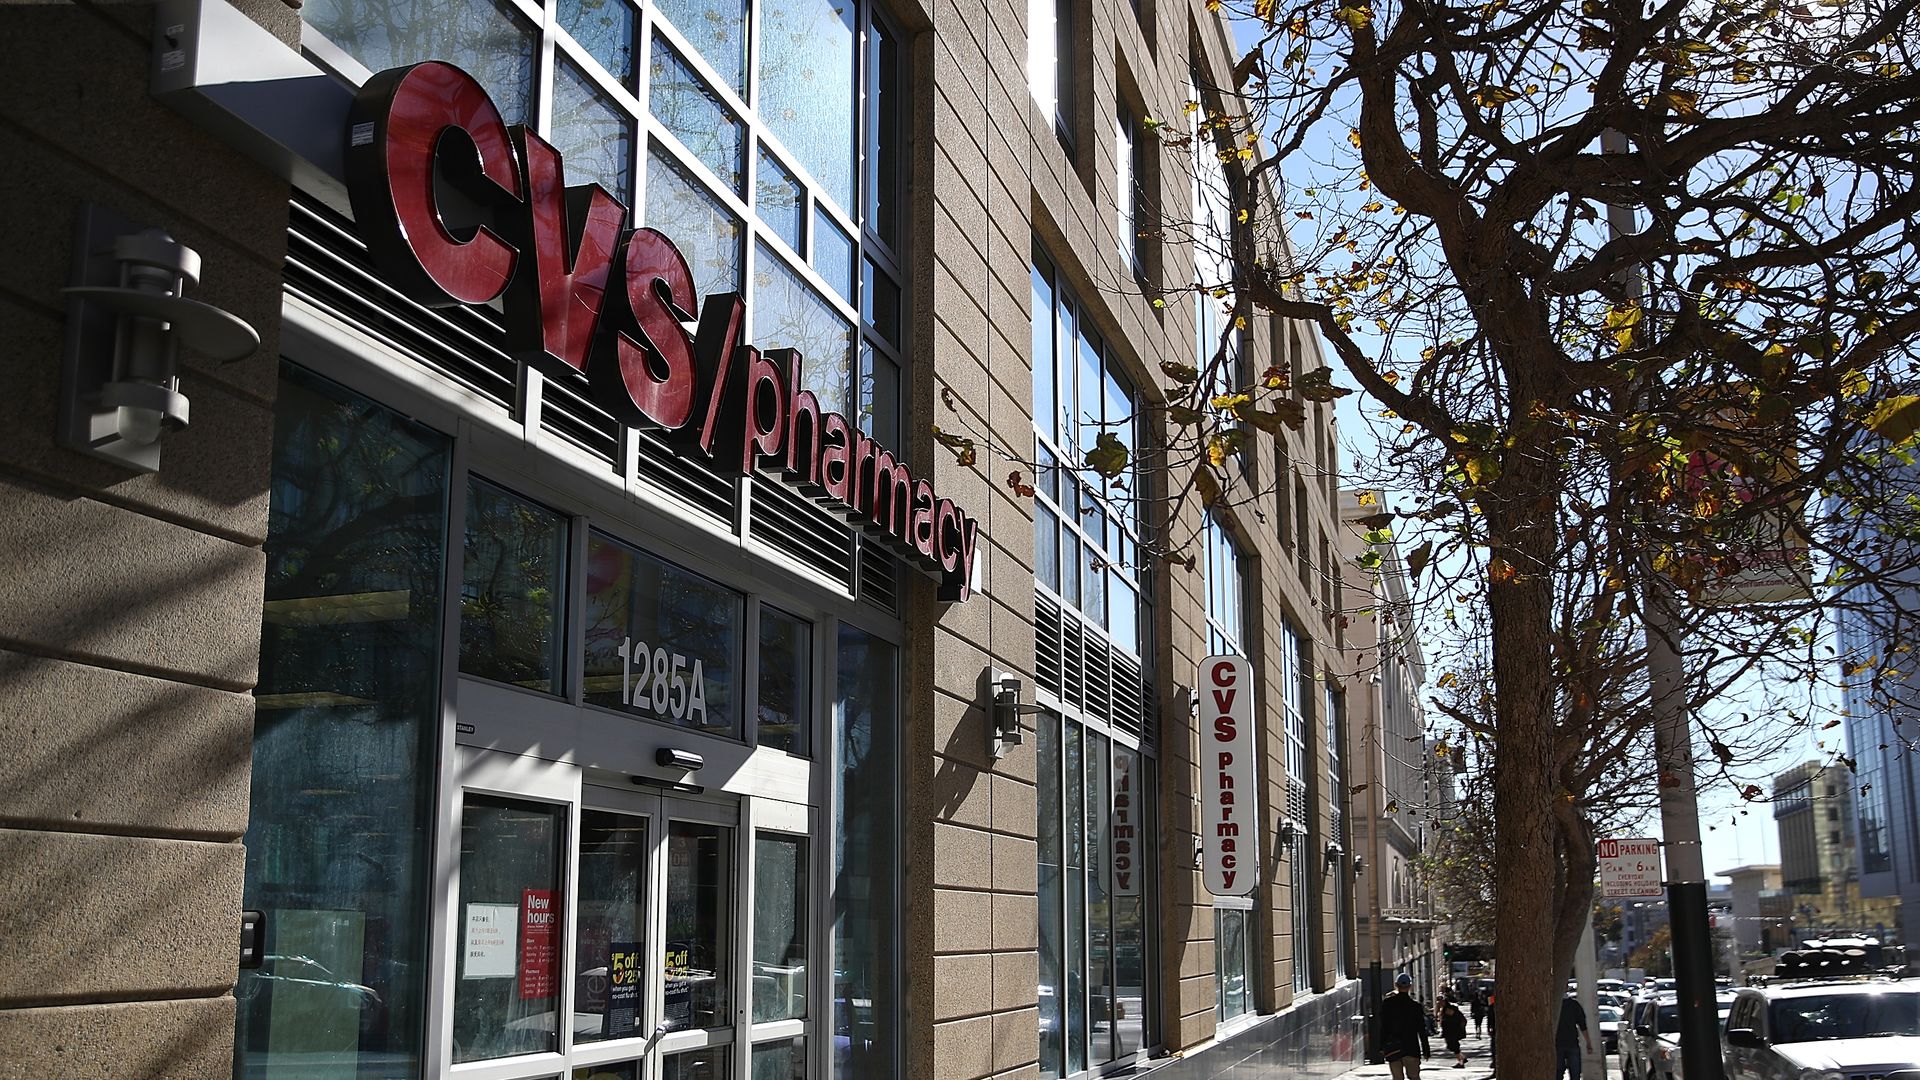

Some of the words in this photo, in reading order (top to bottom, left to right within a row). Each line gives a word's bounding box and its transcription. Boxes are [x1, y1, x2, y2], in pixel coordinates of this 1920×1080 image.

[618, 636, 708, 725] 1285A
[1210, 661, 1237, 743] CVS
[1217, 751, 1239, 890] pharmacy
[1601, 842, 1617, 857] NO
[1620, 844, 1657, 856] PARKING
[1636, 861, 1644, 872] 6
[527, 894, 550, 909] New
[527, 909, 555, 924] hours
[675, 950, 688, 966] off
